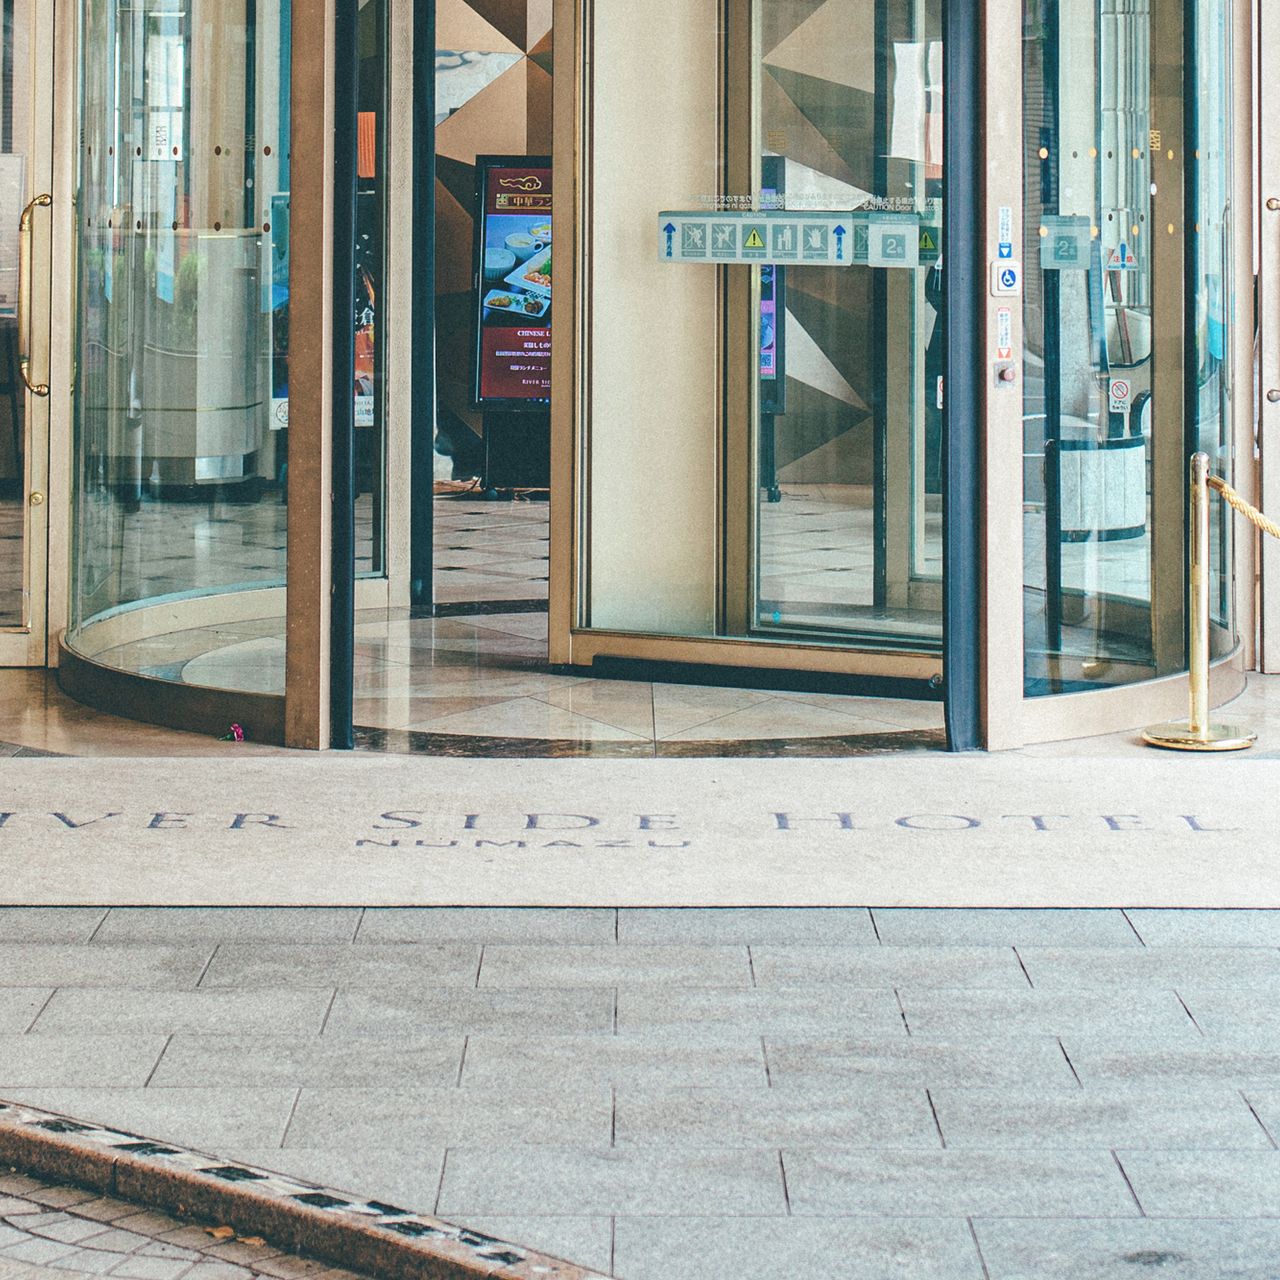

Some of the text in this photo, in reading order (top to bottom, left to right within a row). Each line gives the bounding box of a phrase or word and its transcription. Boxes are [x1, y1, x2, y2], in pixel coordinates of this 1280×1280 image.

[371, 810, 683, 831] SIDE
[771, 811, 1244, 832] HOTEL
[354, 837, 692, 850] NUMAZU
